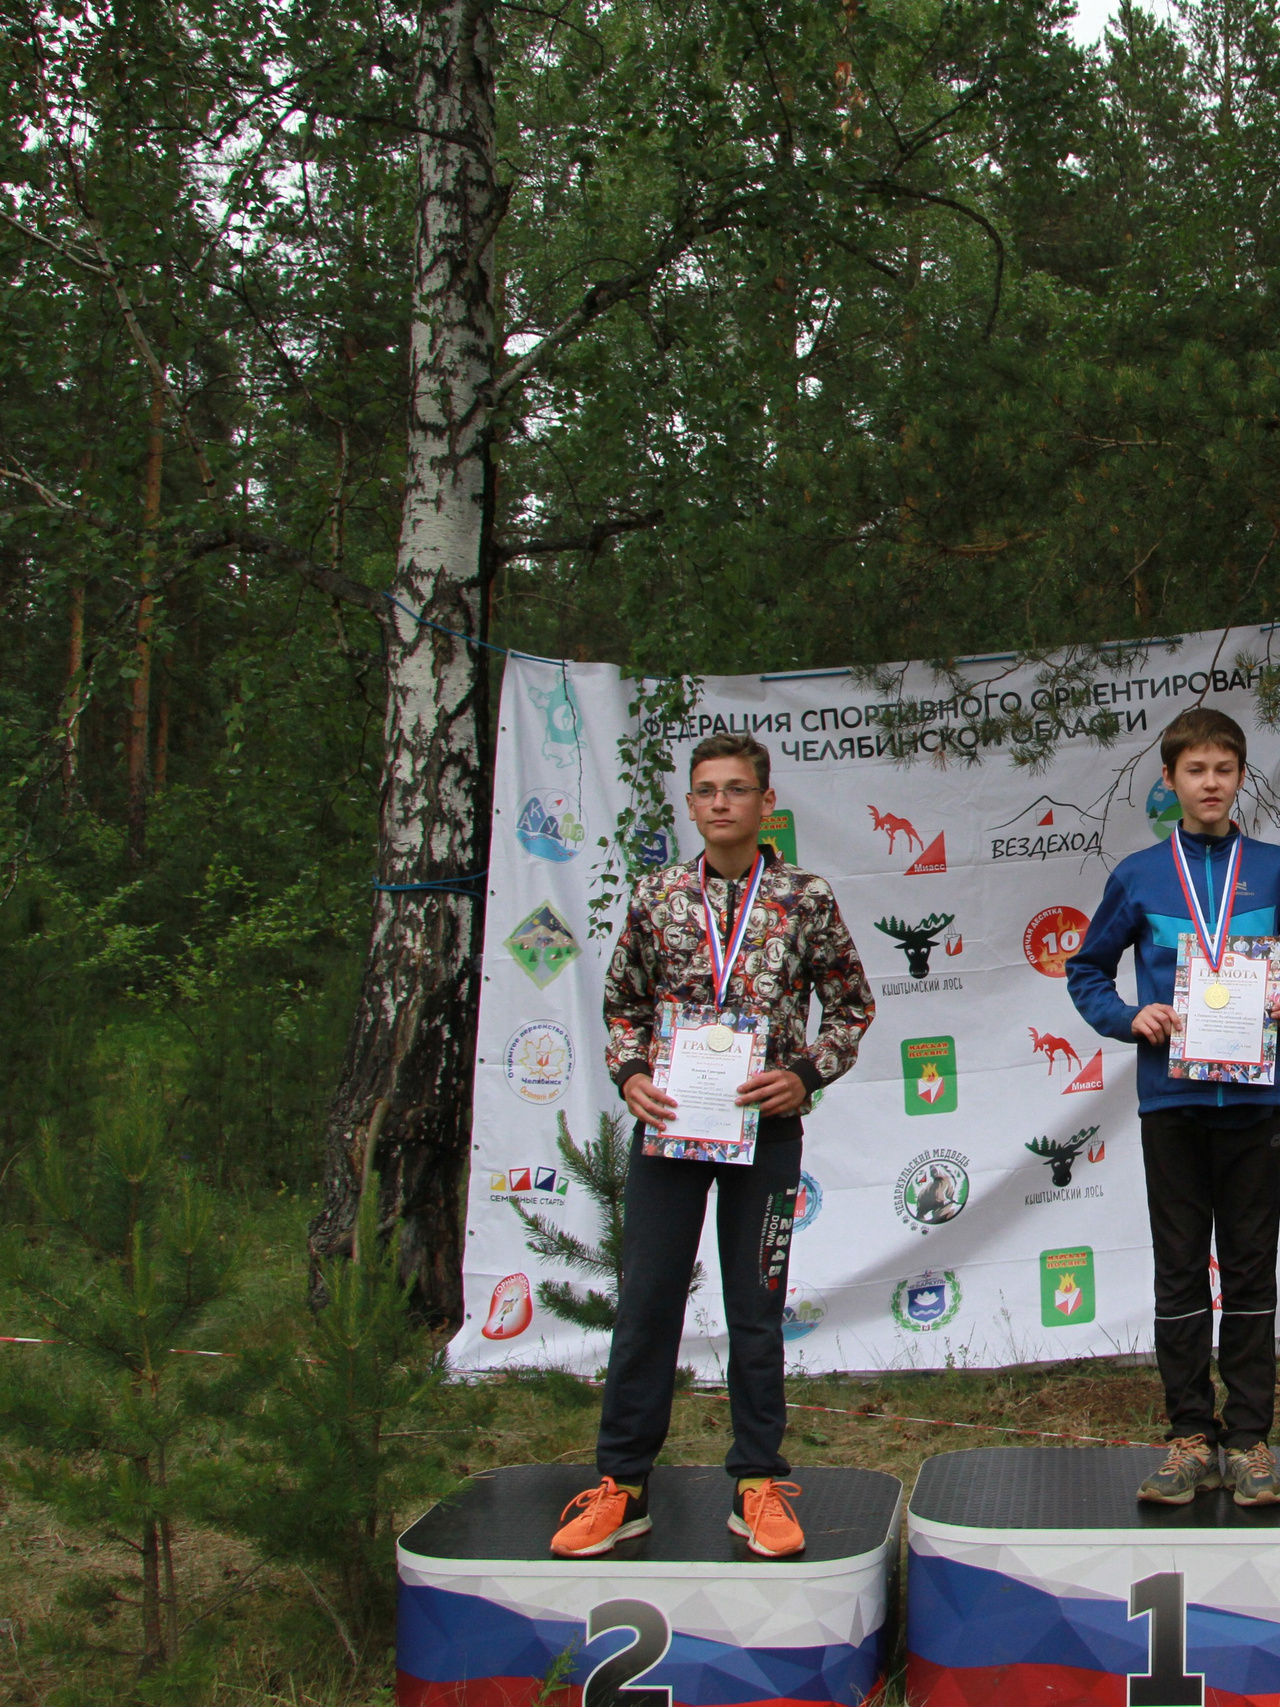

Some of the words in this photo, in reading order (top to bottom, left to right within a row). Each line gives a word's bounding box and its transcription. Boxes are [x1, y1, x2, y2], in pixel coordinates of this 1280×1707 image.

[643, 712, 791, 743] ФЕДЕРАЦИЯ
[1031, 665, 1265, 710] ОРИЕНТИРОВАН
[991, 831, 1101, 861] ВЕЗДЕХОД
[914, 862, 946, 873] Миасс
[1031, 908, 1063, 930] ДЕСЯТКА
[1025, 928, 1038, 964] ГОРЯЧАЯ
[1041, 930, 1081, 954] 10
[881, 978, 940, 996] КЫШТЫМСКИЙ
[942, 977, 964, 991] ЛОСЬ
[908, 1042, 949, 1052] МАЙСКАЯ
[908, 1049, 949, 1059] ПОЛЯНА
[521, 1077, 562, 1085] Челябинск
[1071, 1080, 1102, 1091] Миасс
[893, 1149, 931, 1216] ЧЕБАРКУЛЬСКИЙ
[932, 1148, 971, 1168] МЕДВЕДЬ
[540, 1197, 566, 1206] СТАРТЫ
[1025, 1186, 1081, 1206] КЫШТЫМСКИЙ
[1084, 1184, 1104, 1198] ЛОСЬ
[1046, 1252, 1087, 1262] МАЙСКАЯ
[1046, 1259, 1087, 1269] ПОЛЯНА
[1127, 1572, 1205, 1707] 1
[584, 1598, 673, 1707] 2
